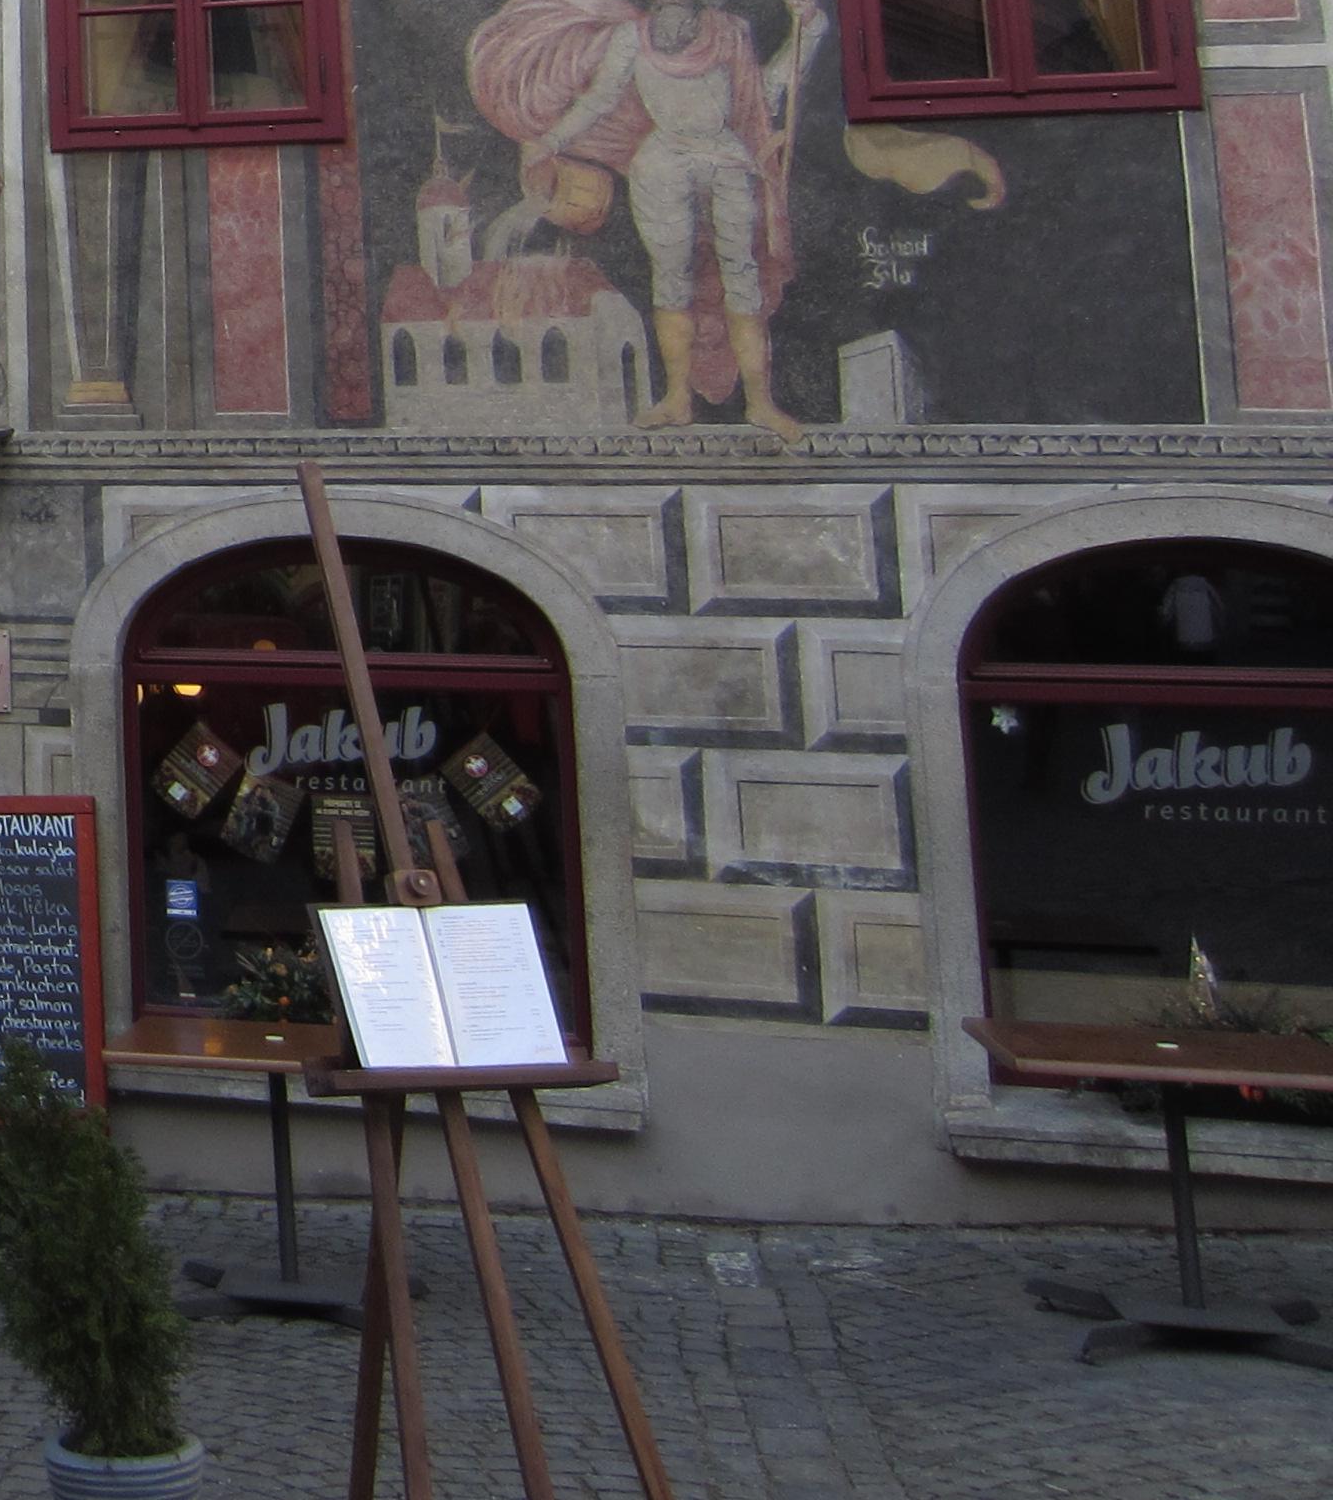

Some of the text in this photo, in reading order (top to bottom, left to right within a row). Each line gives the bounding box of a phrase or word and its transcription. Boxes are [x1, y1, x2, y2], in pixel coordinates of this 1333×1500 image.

[245, 703, 437, 777] Jakub
[1080, 723, 1312, 805] Jakub
[295, 774, 447, 794] restaant
[1144, 803, 1328, 825] restaurant
[15, 839, 76, 863] kulajda
[0, 878, 43, 897] losos
[31, 916, 77, 936] Lachs
[23, 955, 73, 975] Pasta
[19, 993, 73, 1014] salmon
[36, 1032, 83, 1051] cheeks
